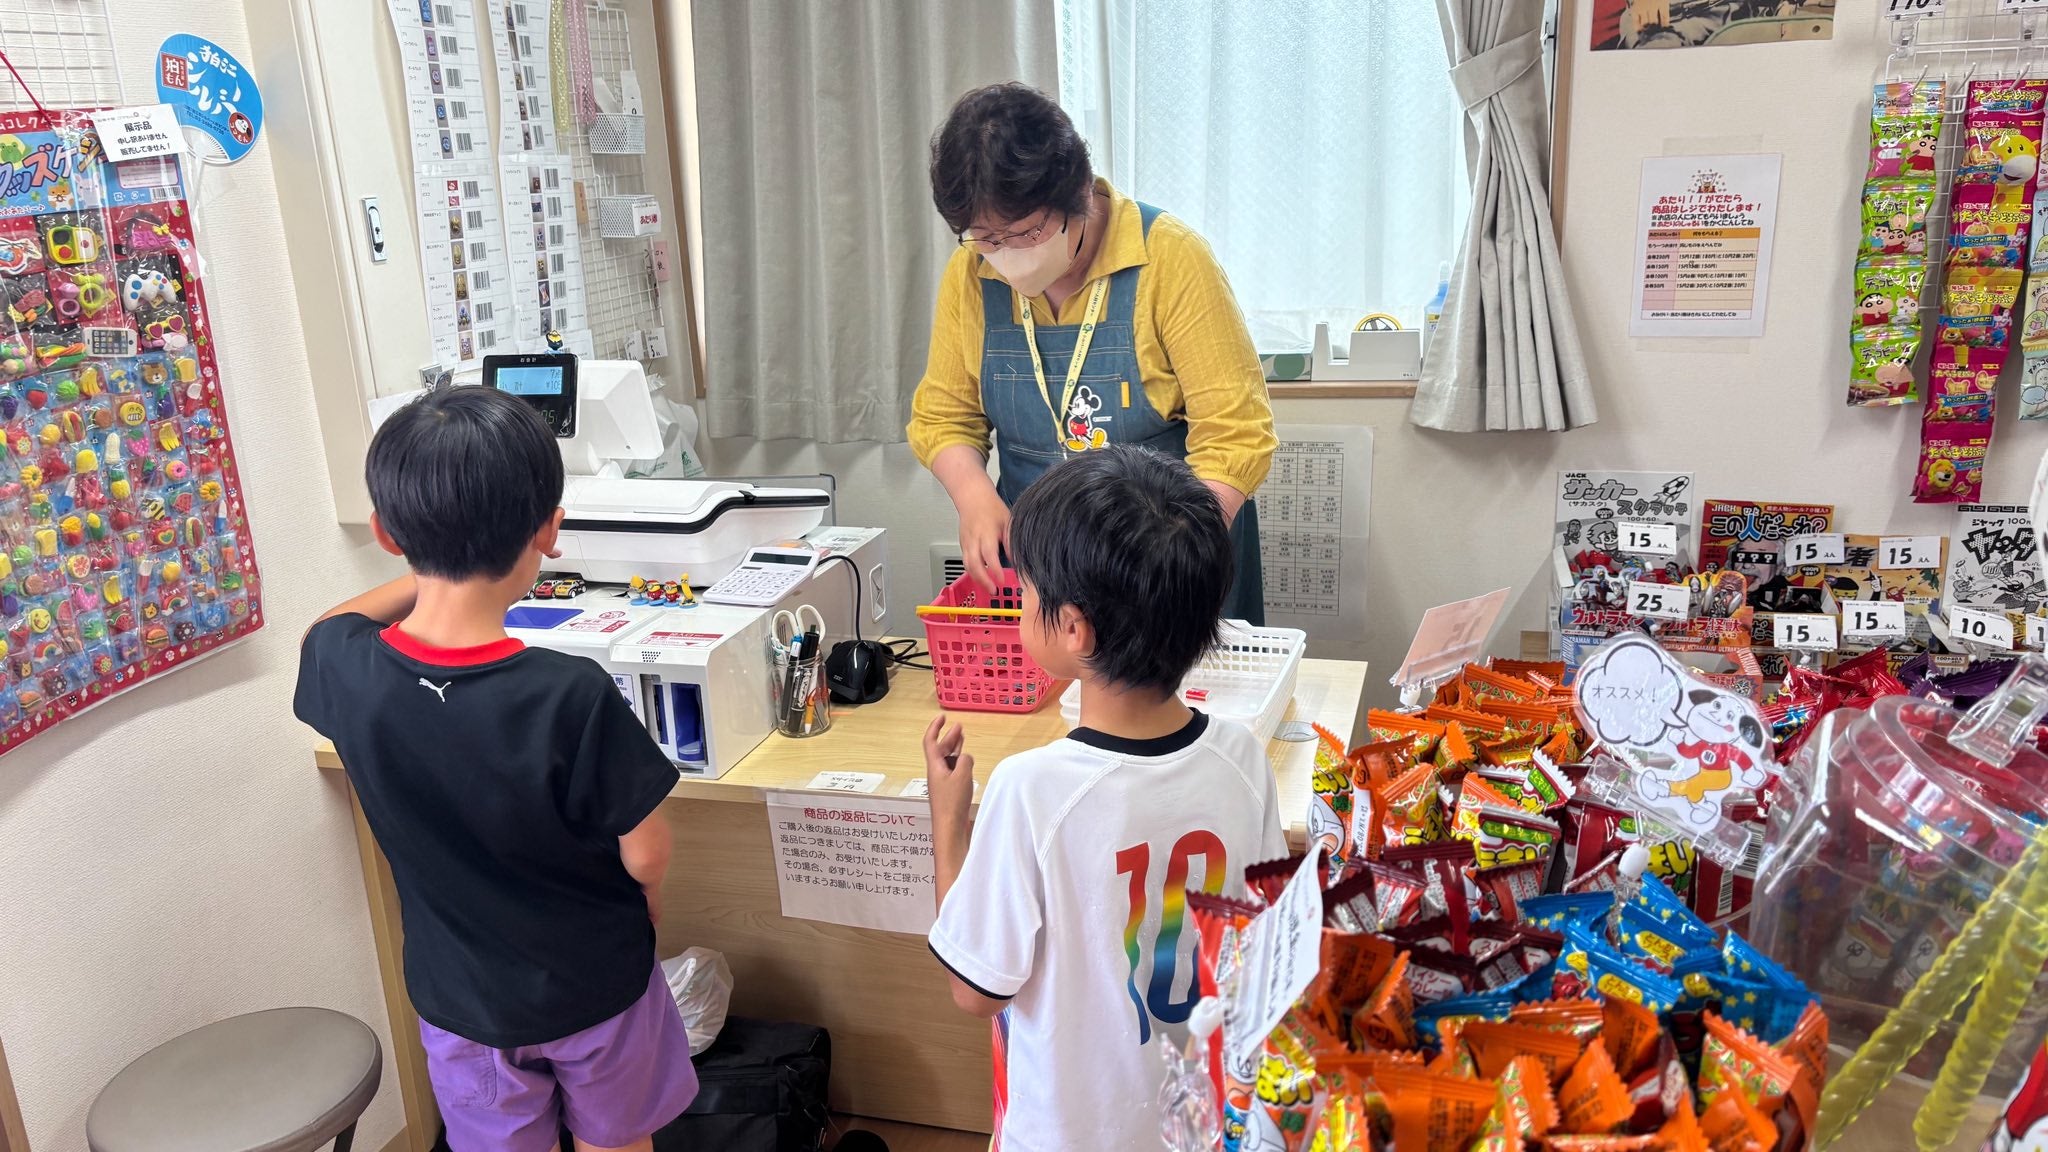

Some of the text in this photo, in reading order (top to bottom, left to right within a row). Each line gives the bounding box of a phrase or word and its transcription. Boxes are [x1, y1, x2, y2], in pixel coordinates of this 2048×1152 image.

[124, 121, 152, 132] 展示品
[1659, 194, 1742, 204] あたり!!がでたら
[1652, 203, 1761, 214] 商品はレジでわたします!
[1961, 209, 2032, 224] たべっ子どうぶつ
[1949, 290, 2015, 304] たべっ子どうぶつ
[1563, 479, 1638, 500] サッカー
[1617, 498, 1688, 516] スクラッチ
[1711, 504, 1737, 512] JACK
[1629, 532, 1651, 547] 15
[1795, 543, 1818, 561] 15
[1889, 547, 1912, 565] 15
[1636, 593, 1662, 612] 25
[1855, 611, 1879, 630] 15
[1962, 618, 1986, 637] 10
[1785, 625, 1810, 642] 15
[1592, 686, 1656, 703] オススメ!
[804, 807, 915, 827] 商品の返品について
[782, 847, 913, 870] た場合のみ、お受けいたします。
[785, 873, 916, 897] いますようお願い申し上げます。
[1115, 829, 1227, 1045] 10
